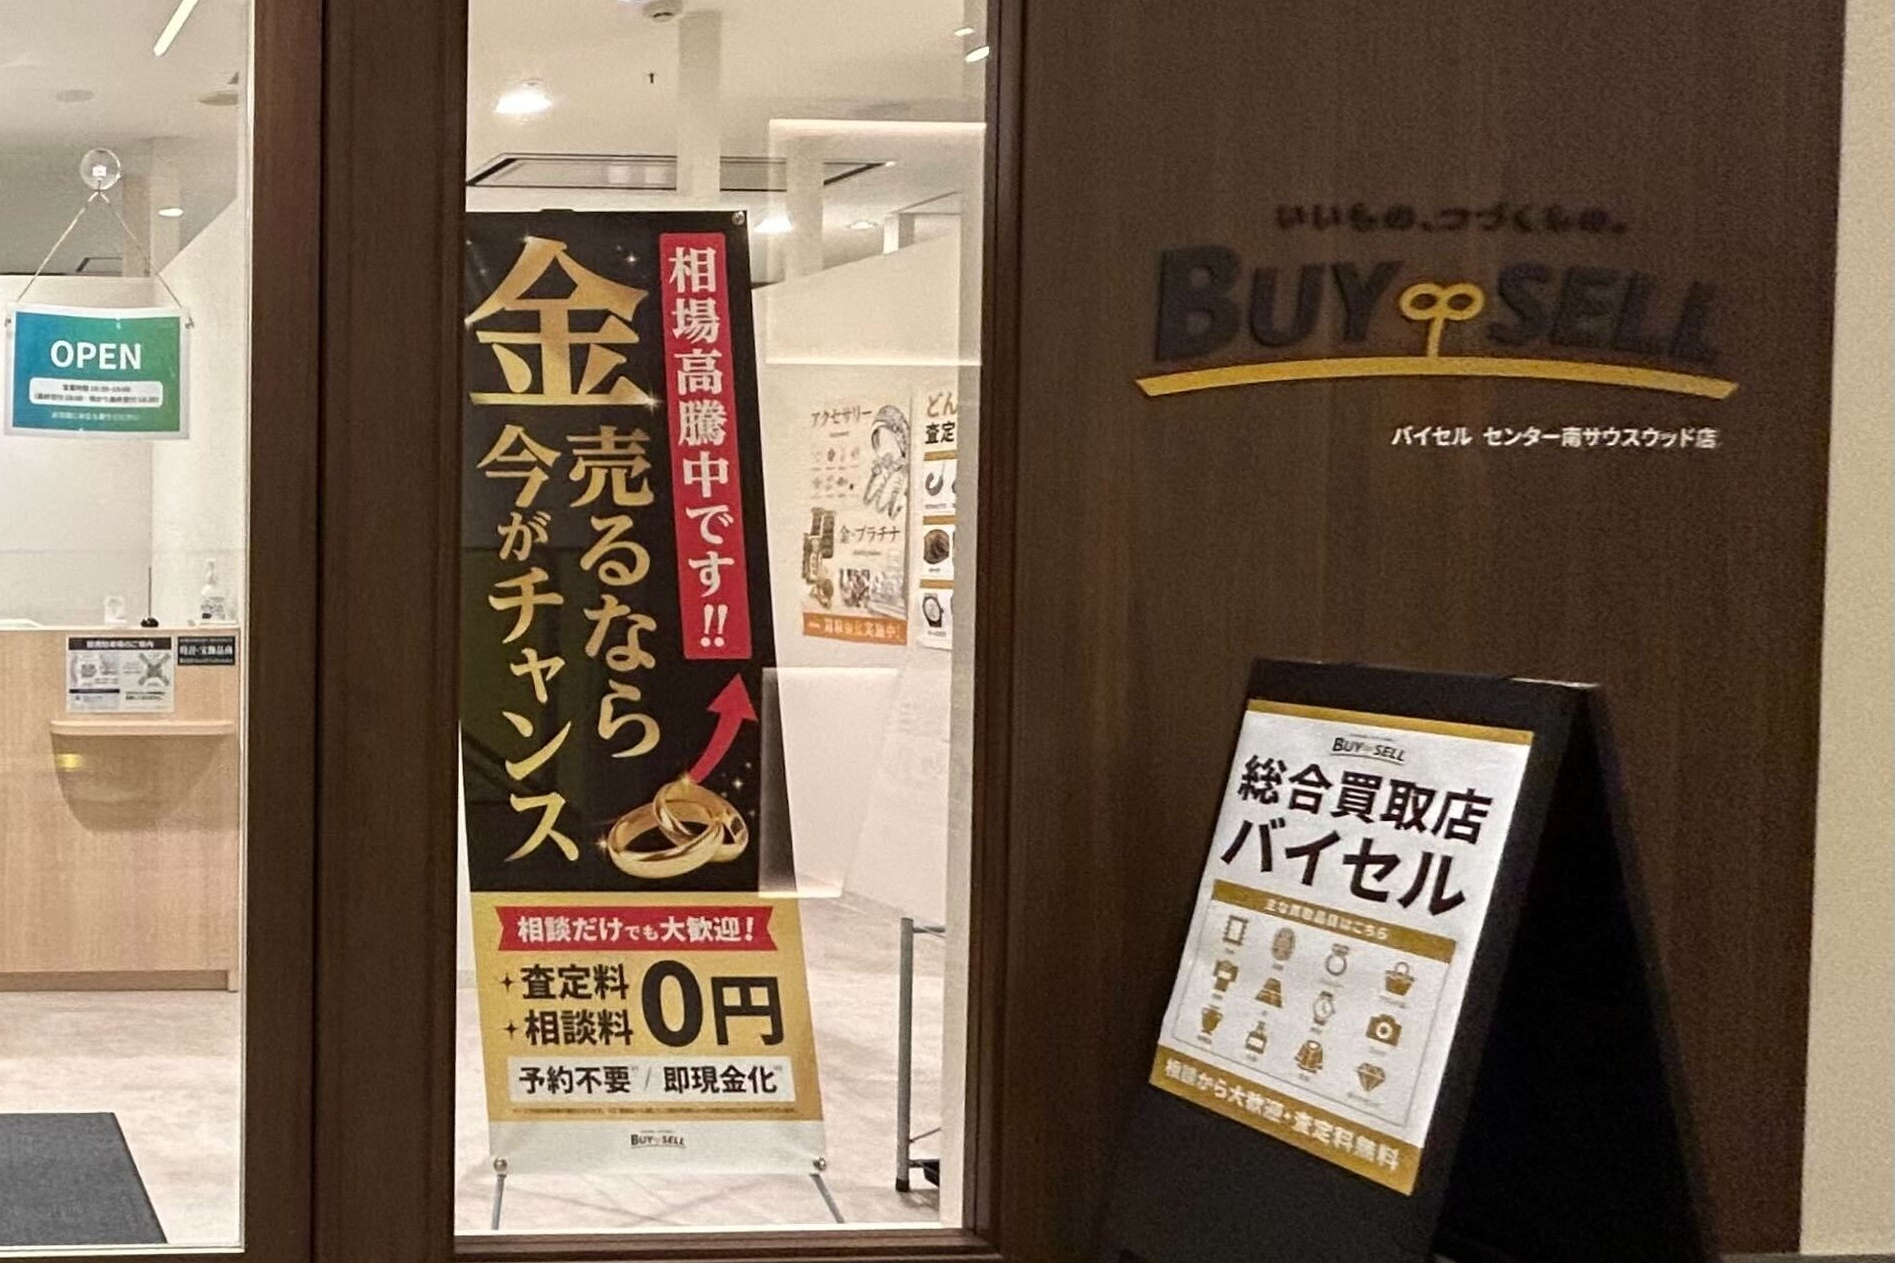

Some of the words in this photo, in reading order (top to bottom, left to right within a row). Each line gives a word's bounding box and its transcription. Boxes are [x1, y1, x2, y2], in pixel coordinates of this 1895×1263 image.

[464, 236, 655, 405] 金
[1154, 244, 1404, 361] BUY
[1488, 262, 1721, 367] SELL
[50, 339, 142, 370] OPEN
[811, 405, 873, 428] アクセサリー
[925, 421, 956, 445] 査定
[1391, 426, 1473, 447] バイセル
[567, 425, 661, 758] 売るなら
[476, 424, 579, 861] 今がチャンス
[1332, 737, 1364, 752] BUY
[1373, 744, 1405, 762] SELL
[1237, 754, 1493, 845] 総合買取店
[1221, 818, 1466, 917] バイセル
[520, 963, 629, 1001] 査定料
[641, 959, 785, 1048] 0円
[524, 1010, 634, 1046] 相談料
[518, 1066, 631, 1094] 予約不要
[663, 1066, 778, 1094] 即現金化
[630, 1134, 653, 1146] BUY
[662, 1135, 685, 1146] SELL
